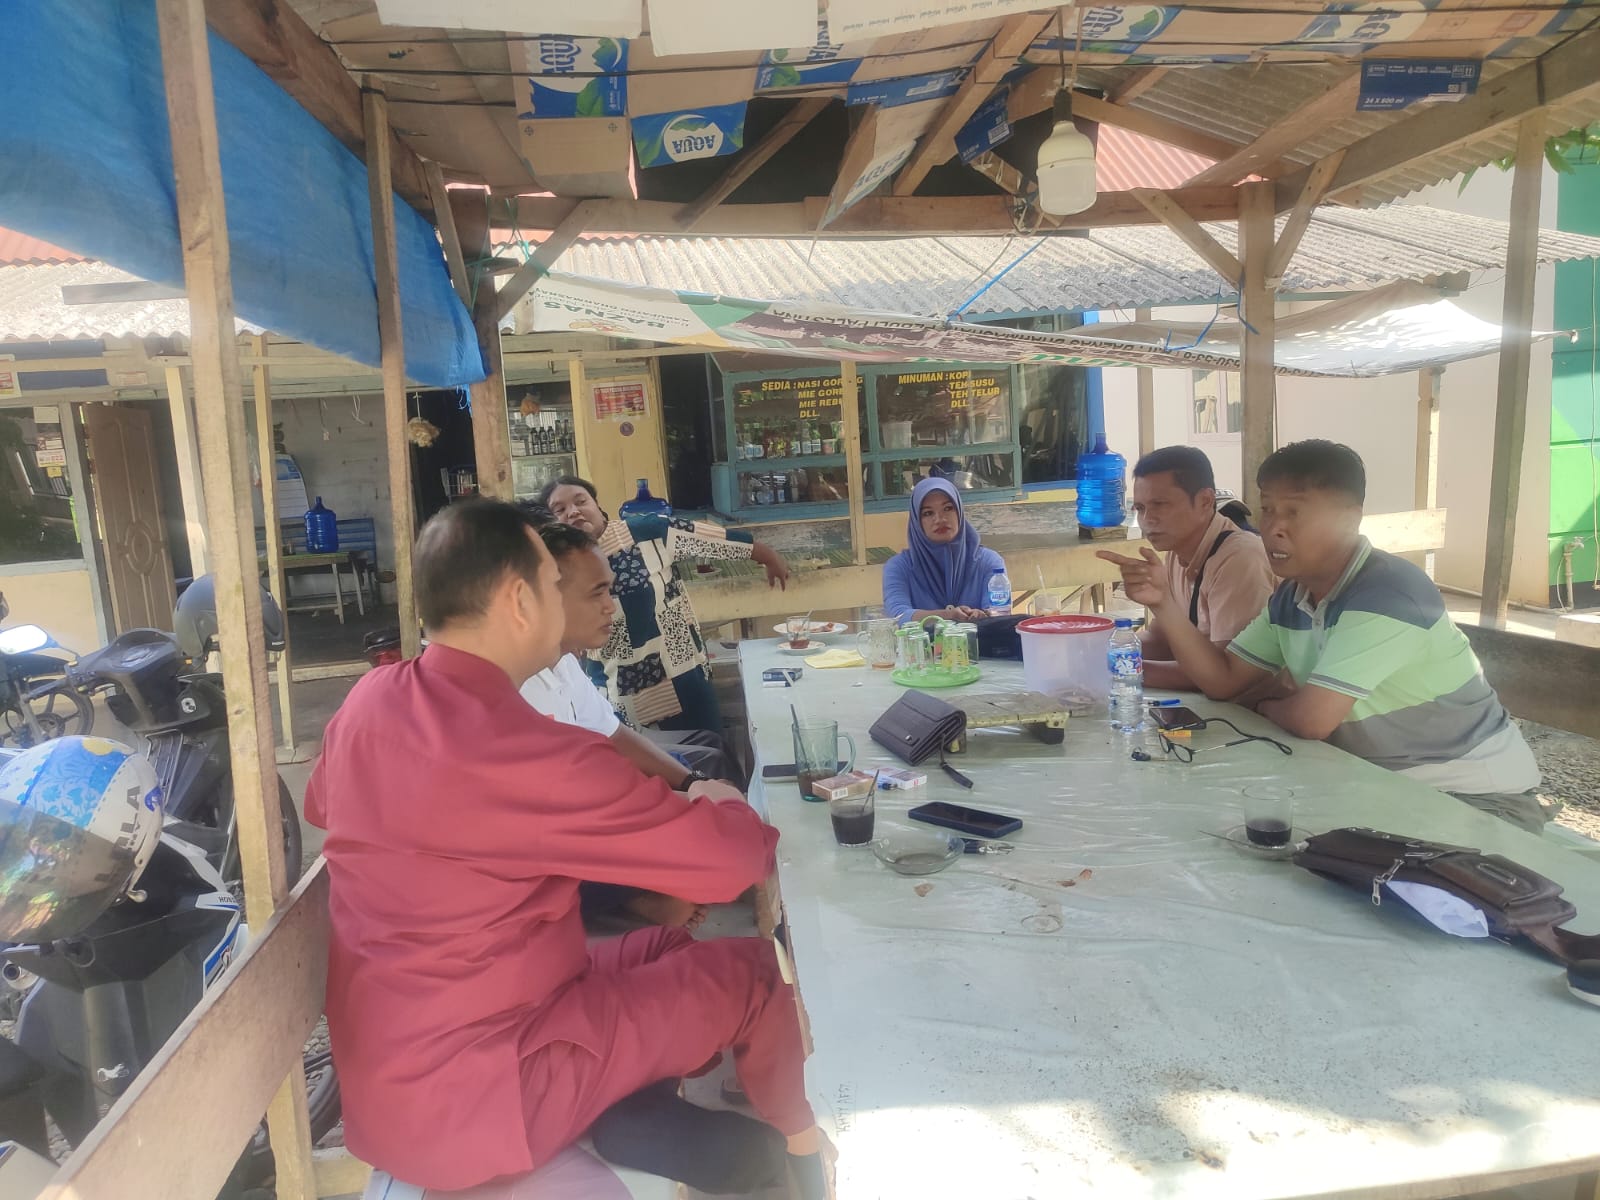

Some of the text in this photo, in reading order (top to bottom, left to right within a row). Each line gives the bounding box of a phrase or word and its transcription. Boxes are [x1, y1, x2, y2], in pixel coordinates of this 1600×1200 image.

[672, 135, 717, 154] AQUA
[544, 301, 666, 329] BAZNAS
[898, 372, 943, 384] MINUMAN
[970, 378, 995, 387] SUSU
[761, 381, 791, 391] SEDIA
[798, 390, 816, 399] MIE
[950, 387, 1000, 399] TEH TELUR
[799, 400, 817, 409] MIE
